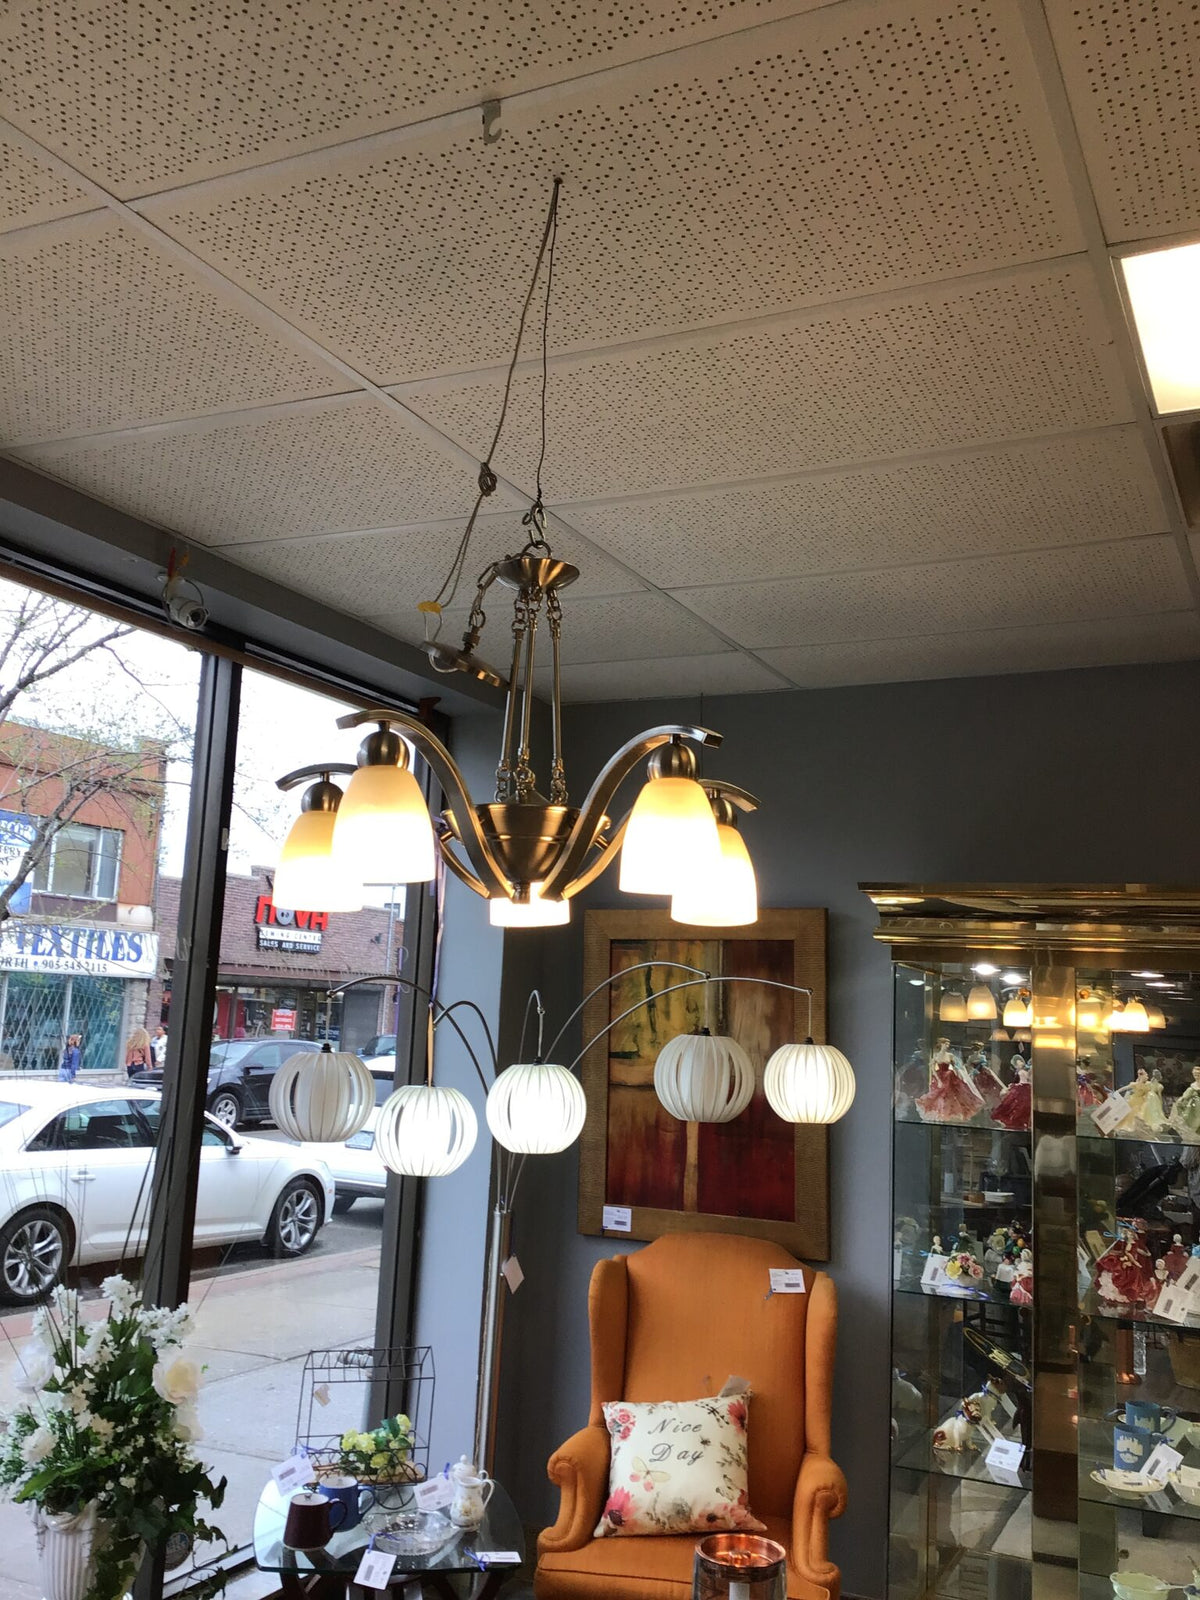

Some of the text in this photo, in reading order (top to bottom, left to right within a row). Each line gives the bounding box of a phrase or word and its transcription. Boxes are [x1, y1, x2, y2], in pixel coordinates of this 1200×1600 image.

[15, 922, 143, 962] TEXTILES
[259, 939, 278, 948] SALES
[295, 942, 320, 951] SERVICE
[42, 960, 108, 973] 905-5452115
[647, 1418, 703, 1435] Nice
[649, 1442, 704, 1466] Day
